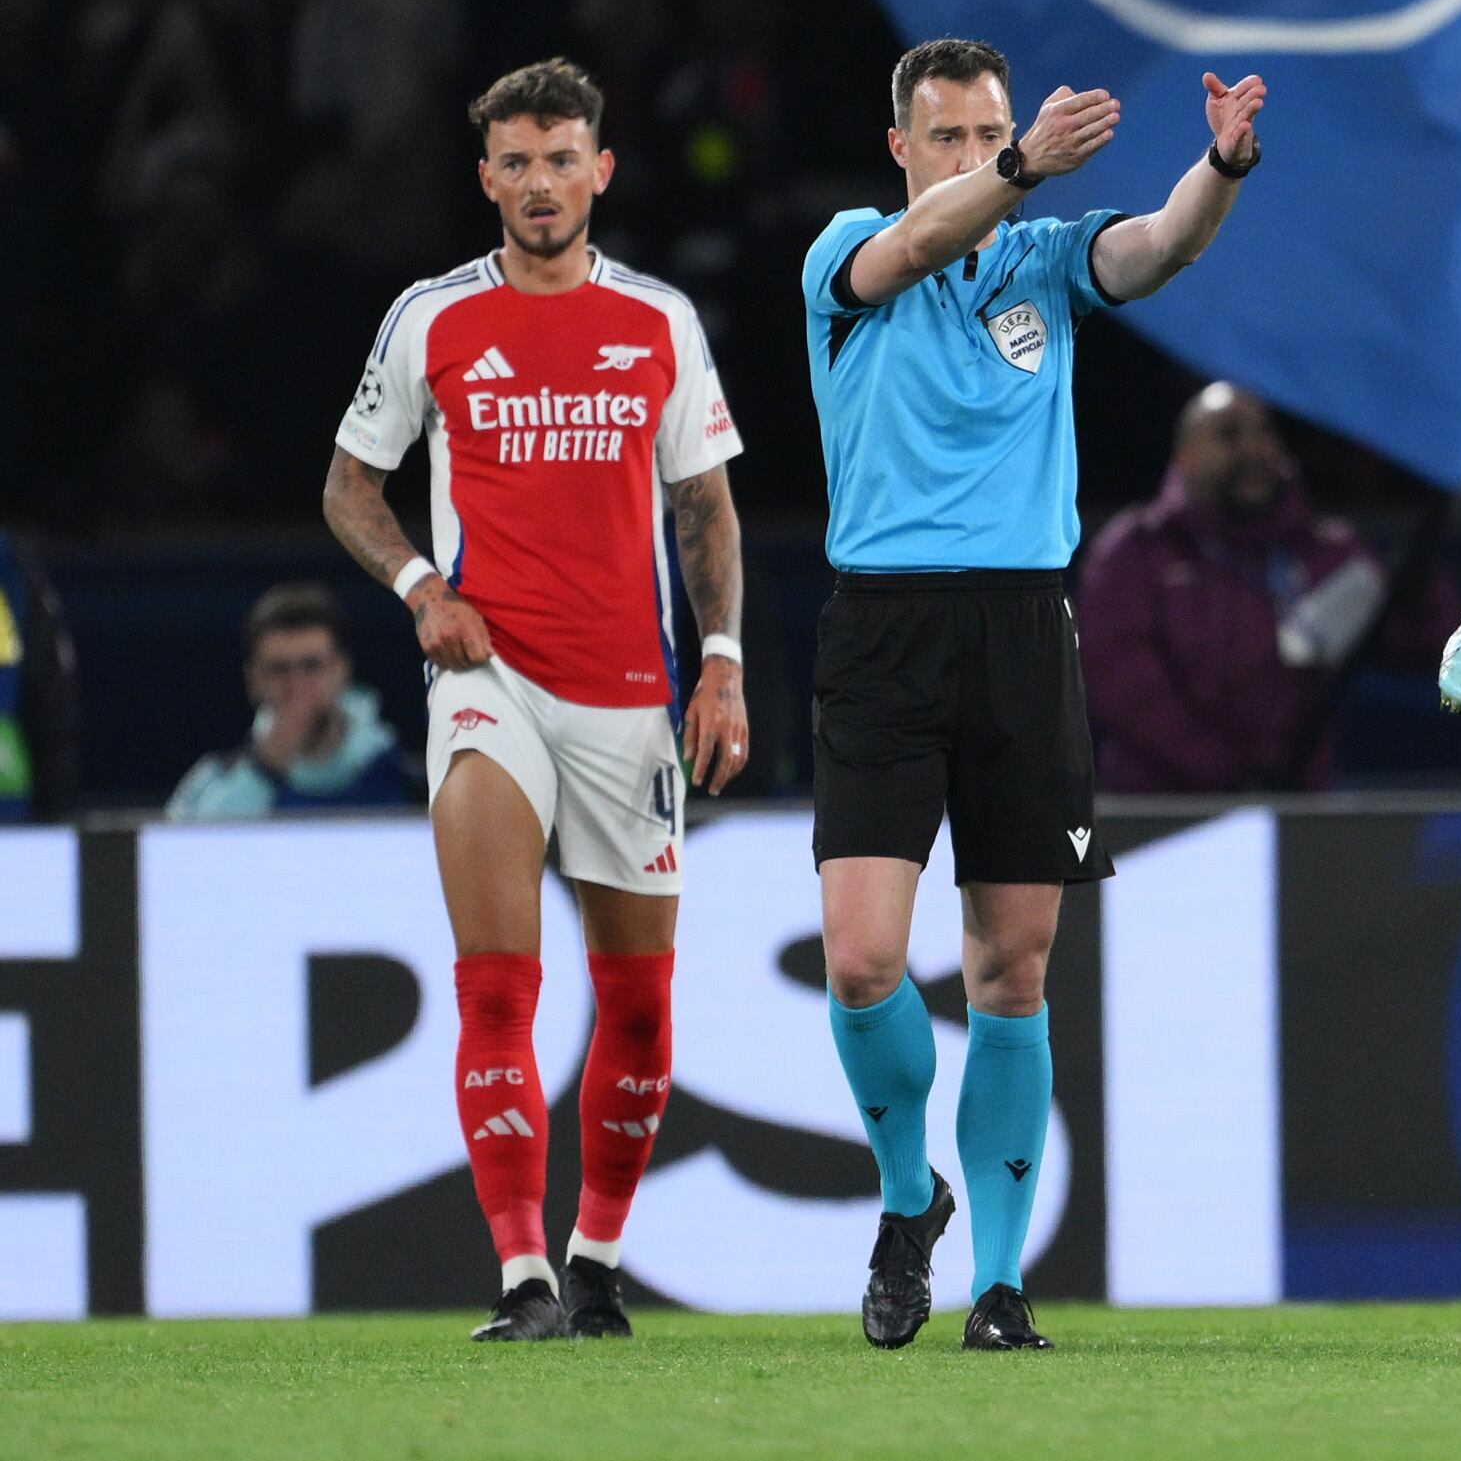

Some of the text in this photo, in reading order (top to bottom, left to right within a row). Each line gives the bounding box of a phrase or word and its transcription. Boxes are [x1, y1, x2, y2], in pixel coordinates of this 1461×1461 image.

[1001, 313, 1031, 334] UEFA
[1009, 329, 1039, 349] MATCH
[1010, 339, 1046, 360] OFFICIAL
[467, 386, 648, 430] Emirates
[499, 428, 623, 464] FLY BETTER
[653, 764, 676, 836] 4
[464, 1068, 525, 1089] AFC
[616, 1074, 670, 1096] AFC
